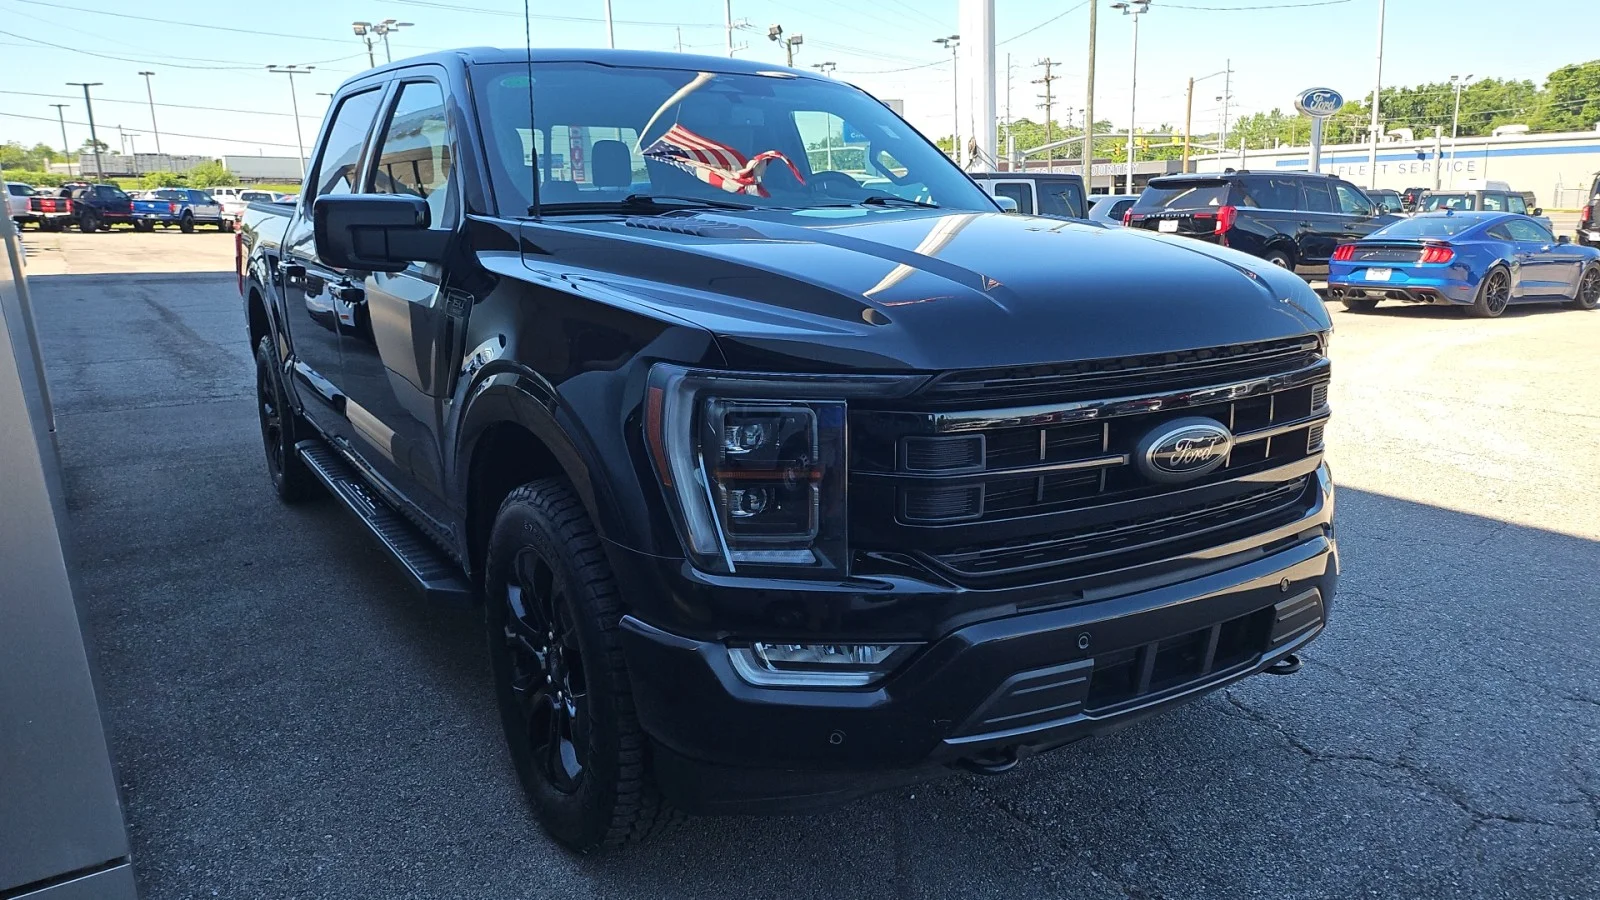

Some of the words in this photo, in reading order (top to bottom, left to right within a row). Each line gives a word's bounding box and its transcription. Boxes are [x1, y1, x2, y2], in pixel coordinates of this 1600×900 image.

[1310, 93, 1336, 111] Ford
[570, 127, 584, 180] DRIVE
[1338, 164, 1388, 176] FLET
[1169, 437, 1217, 466] Ford
